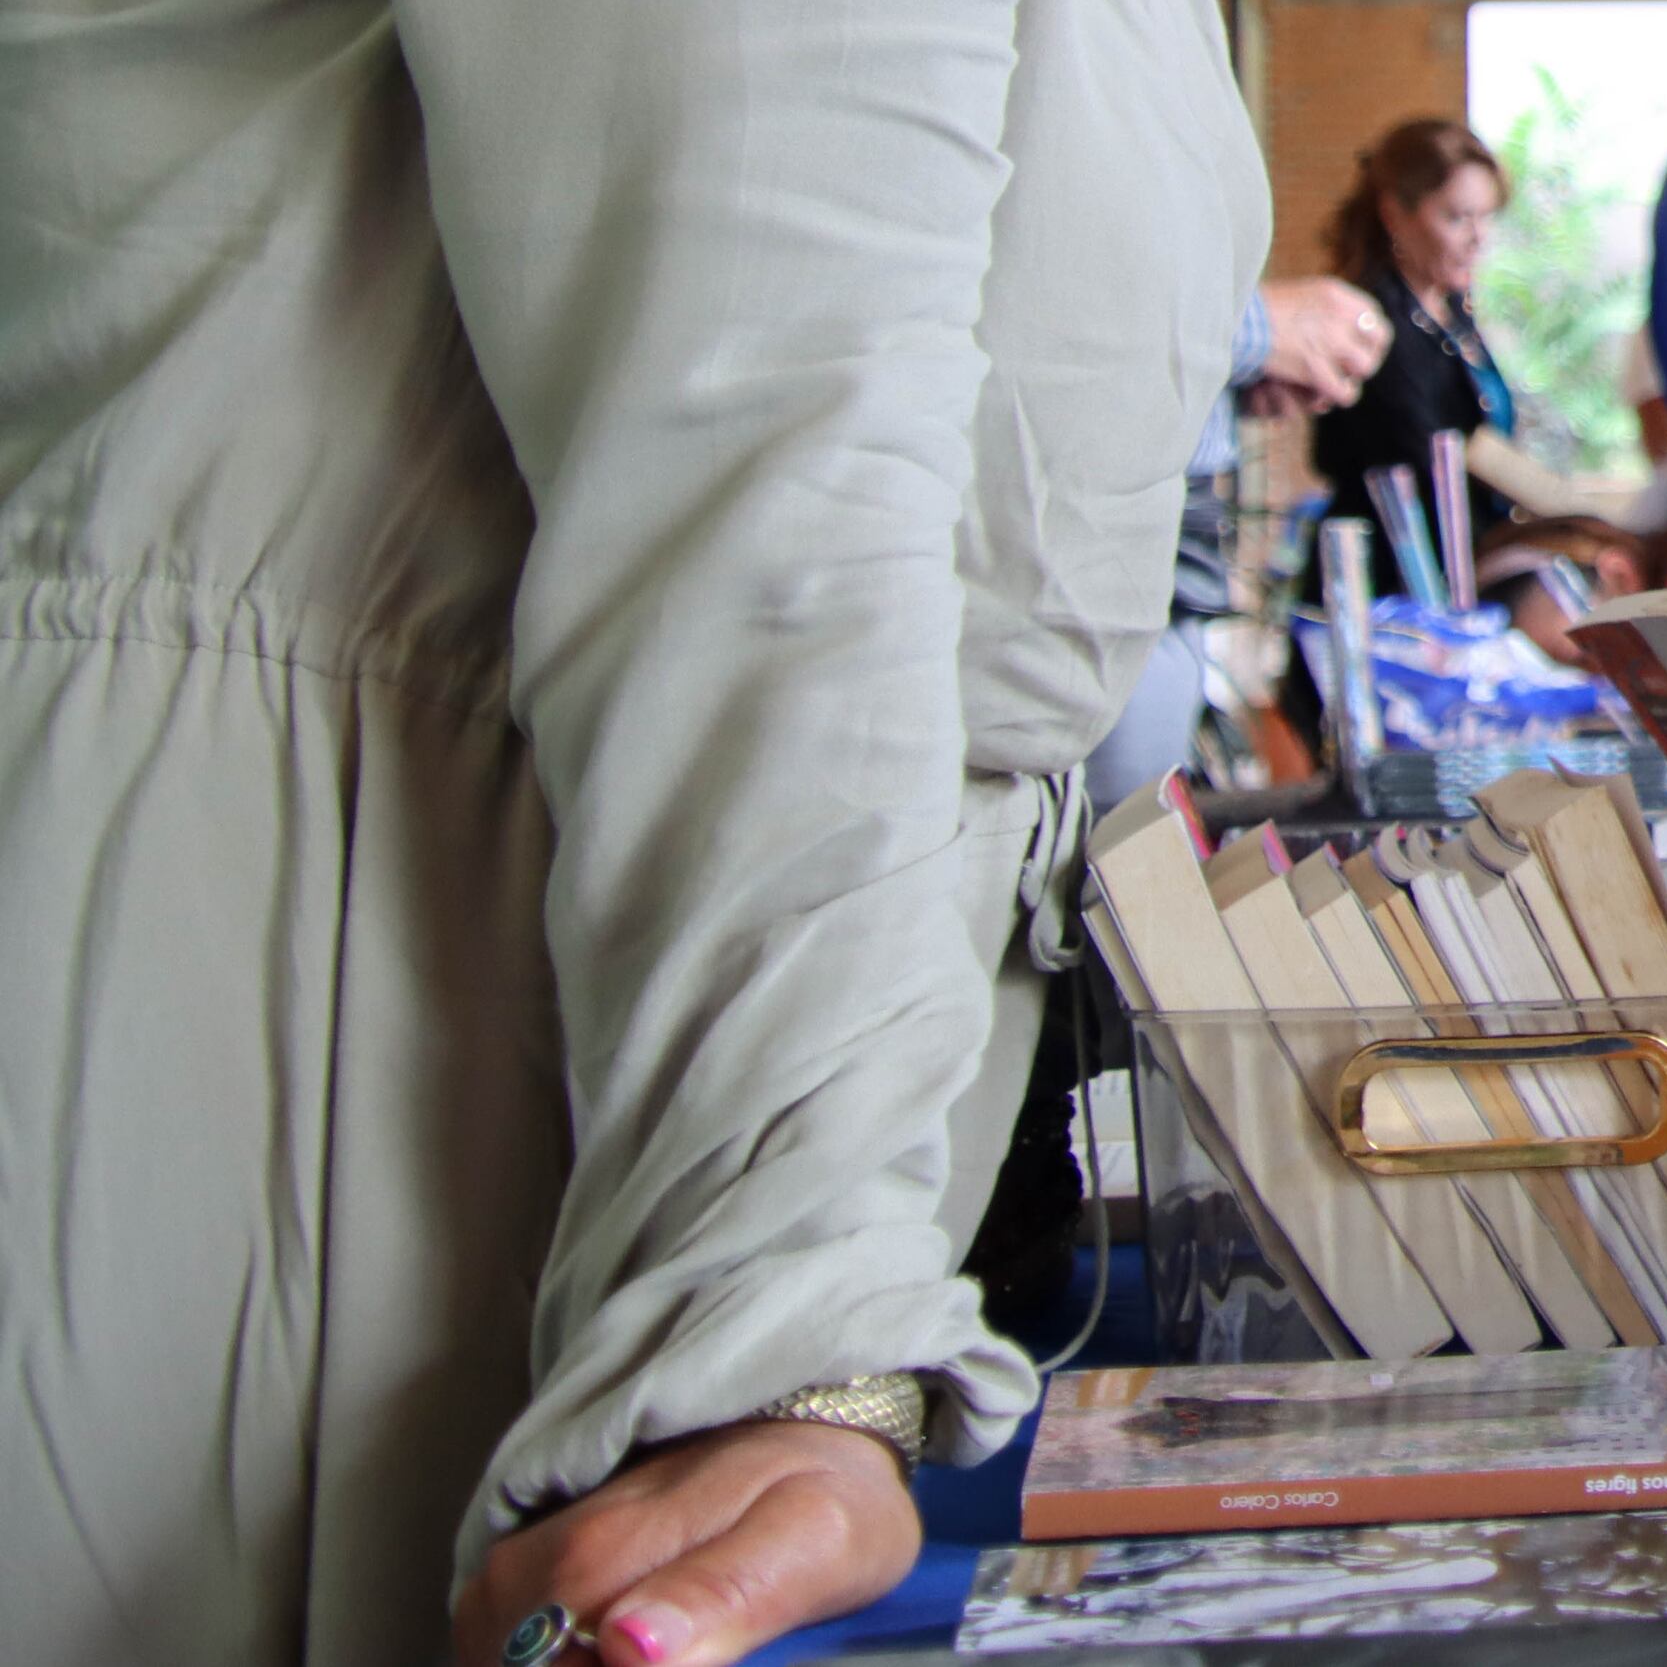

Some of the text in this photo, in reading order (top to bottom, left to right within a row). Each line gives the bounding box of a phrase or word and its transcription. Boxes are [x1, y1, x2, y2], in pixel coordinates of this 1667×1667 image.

[1585, 1473, 1638, 1497] tigres
[1221, 1489, 1340, 1515] Carlos Calero
